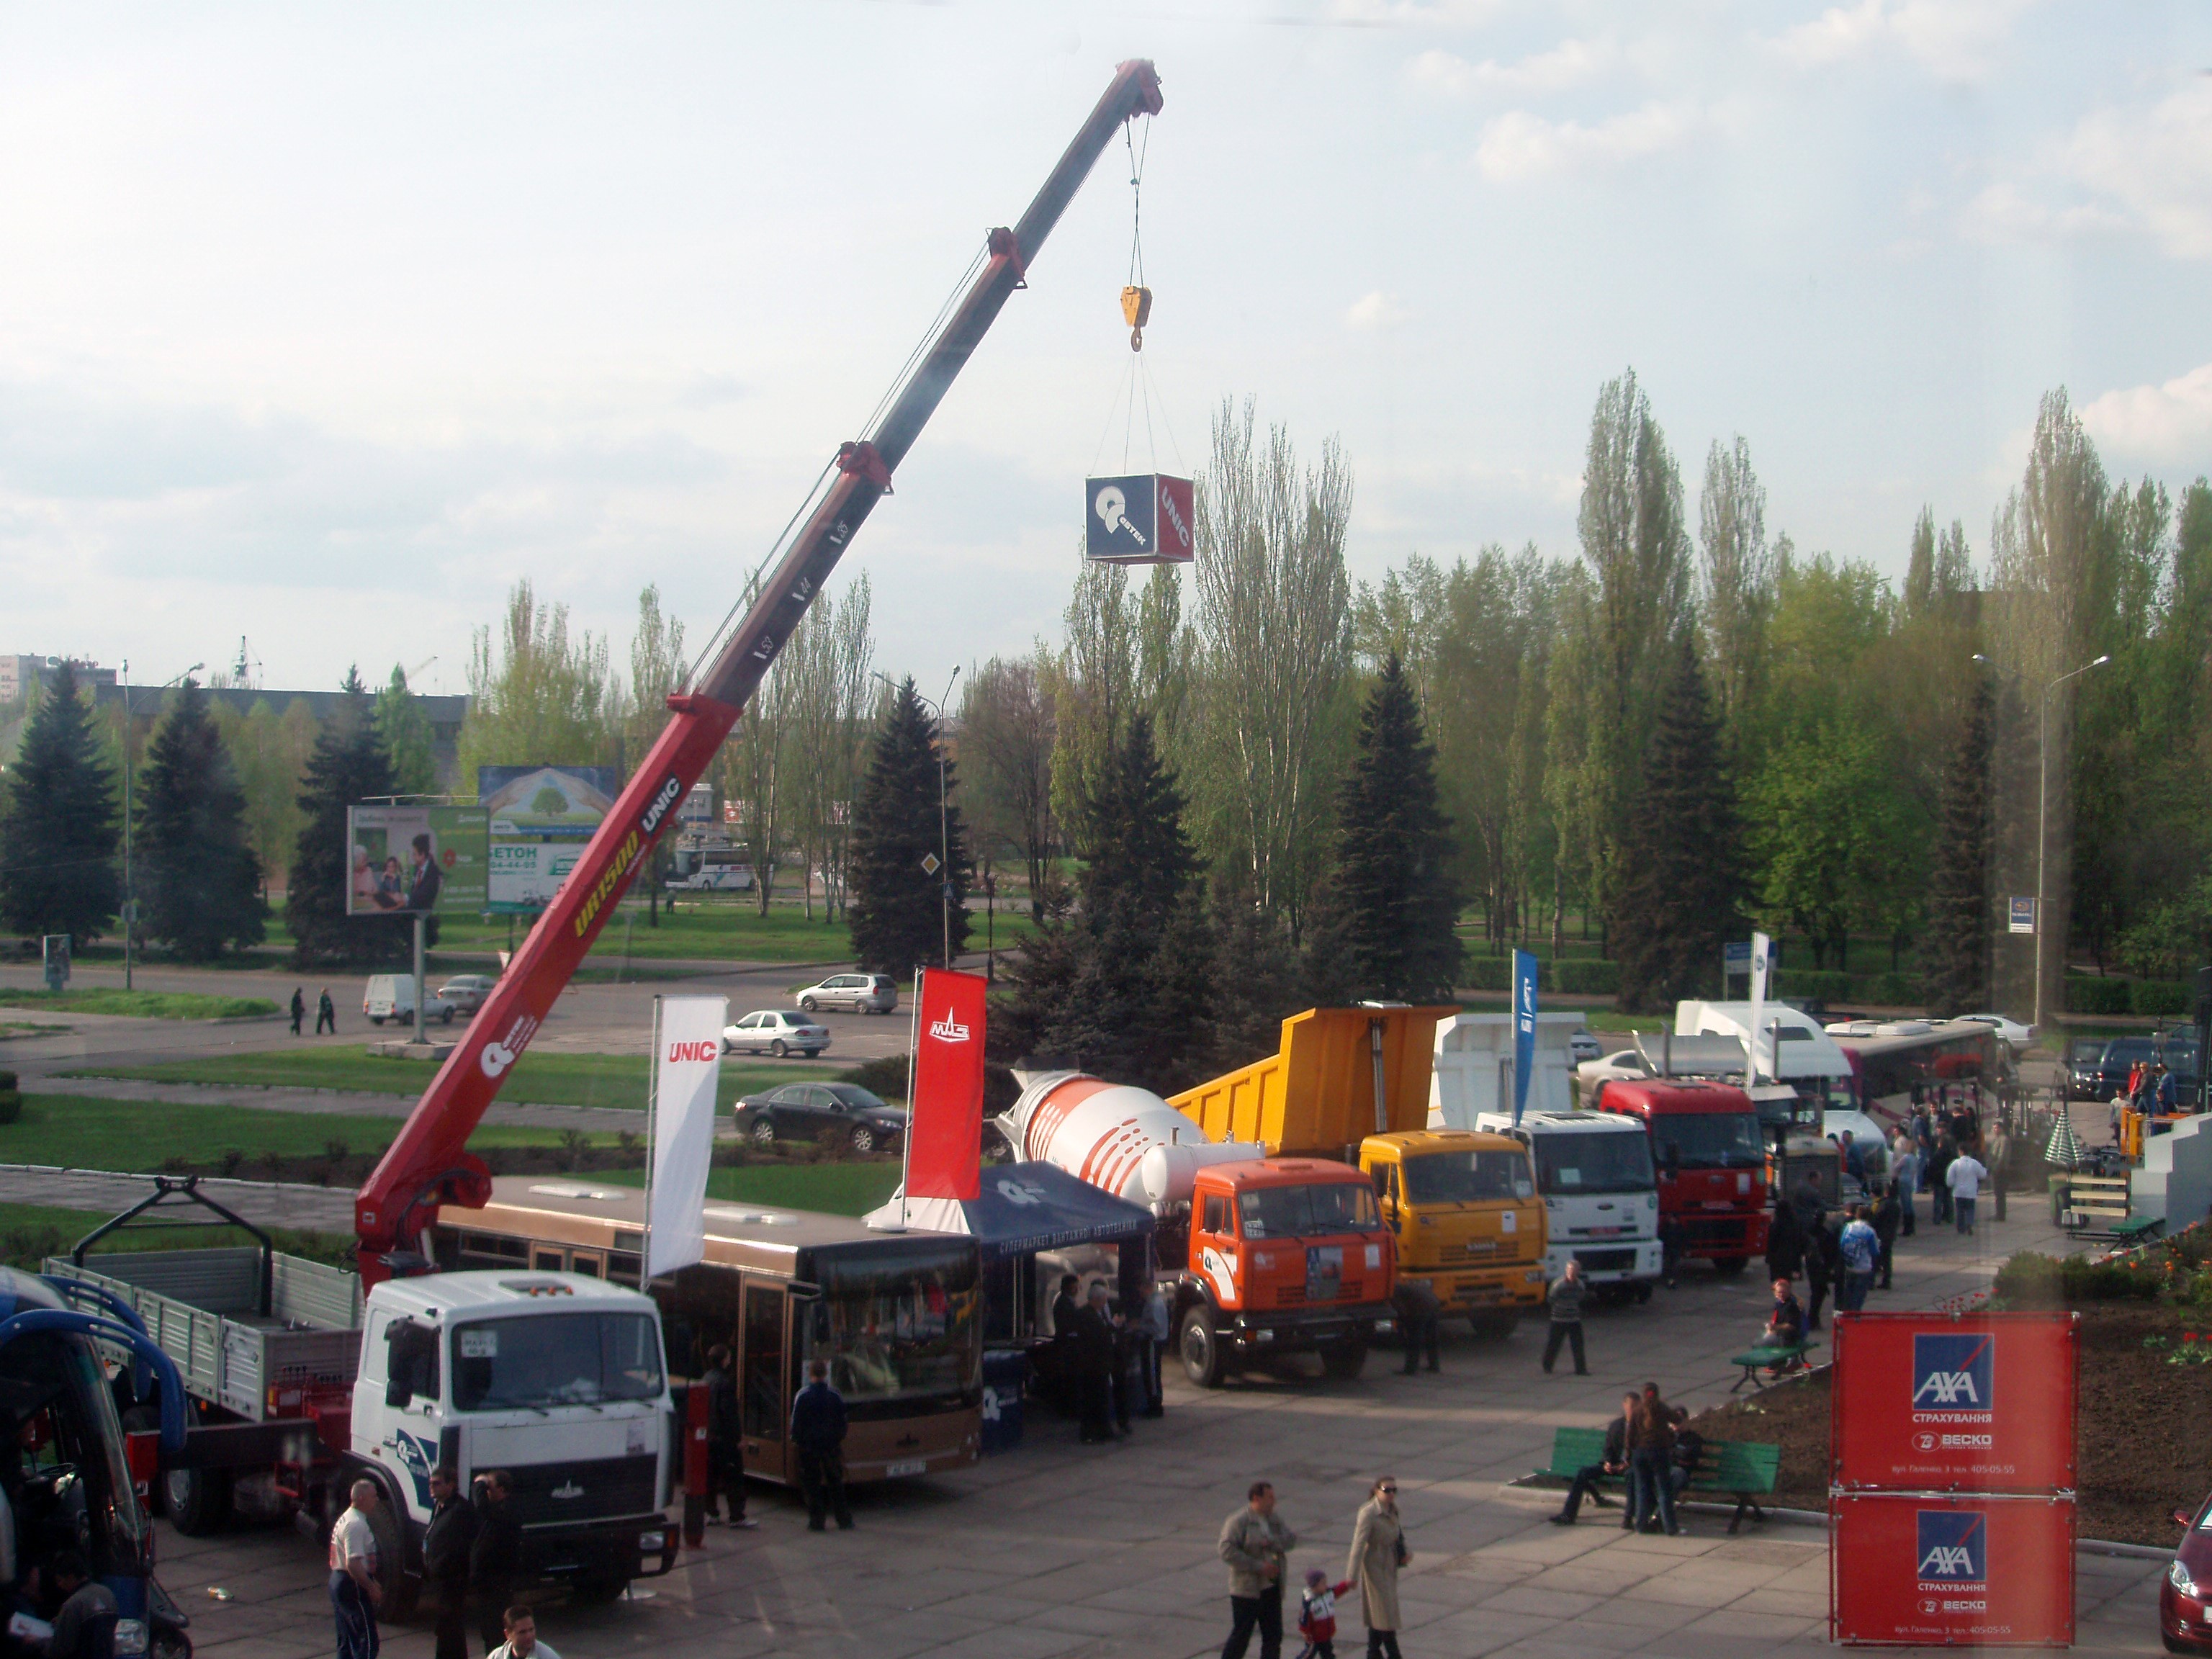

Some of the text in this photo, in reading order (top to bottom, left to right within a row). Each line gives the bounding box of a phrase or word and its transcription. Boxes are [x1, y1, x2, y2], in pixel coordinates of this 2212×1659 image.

[1161, 485, 1190, 547] UNIC
[642, 777, 680, 832] UNIC
[669, 1040, 718, 1064] UNIC
[1912, 1372, 1979, 1403] AXA
[1912, 1413, 1992, 1424] СТРАХУВАННЯ
[1918, 1546, 1975, 1575] AXA
[1918, 1583, 1987, 1592] СТРАХУВАННЯ
[1969, 1625, 2011, 1635] 405-05-55
